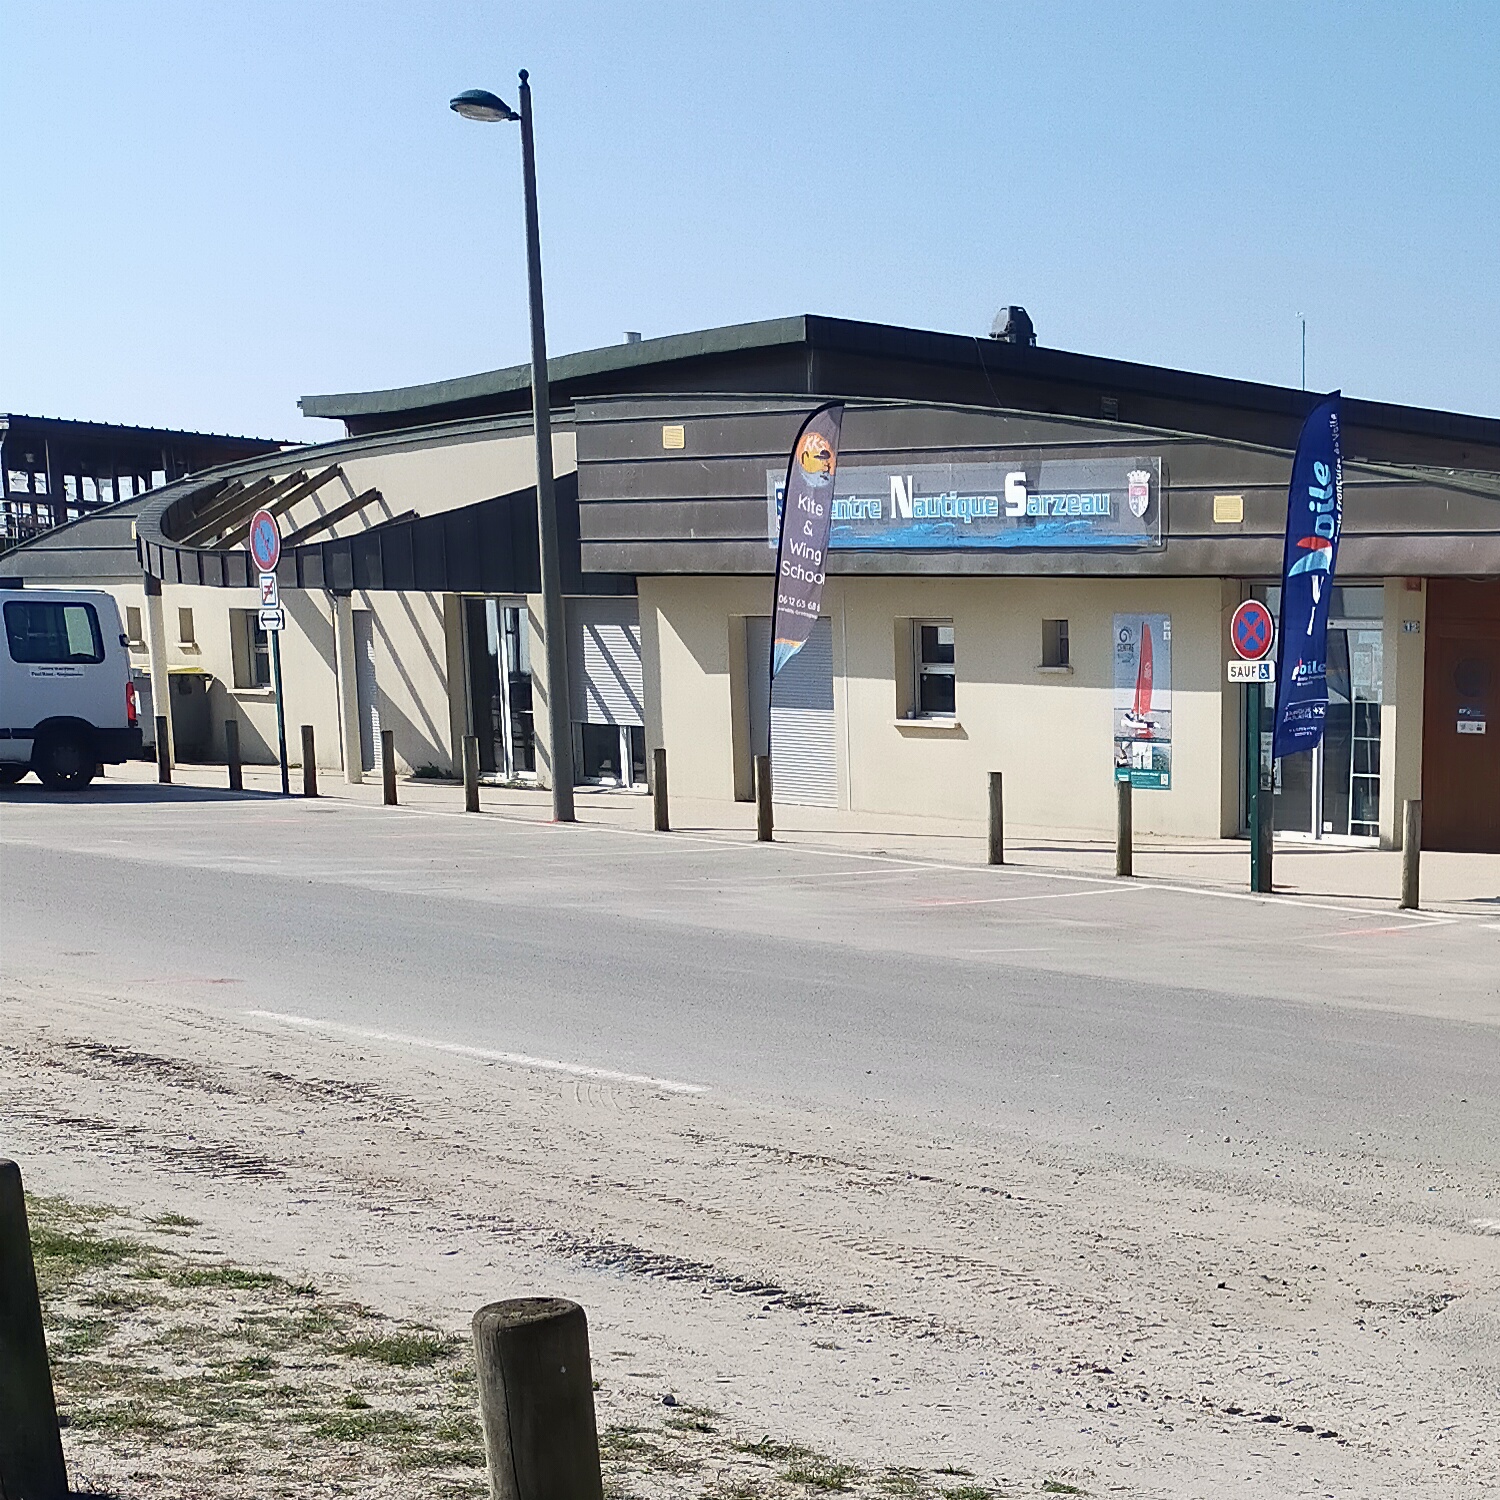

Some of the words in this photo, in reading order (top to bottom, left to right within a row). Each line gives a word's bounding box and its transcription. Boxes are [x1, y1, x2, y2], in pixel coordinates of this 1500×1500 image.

[797, 494, 824, 516] Kite
[890, 475, 999, 523] Nautique
[1004, 472, 1111, 517] Sarzeau
[803, 520, 813, 537] &
[789, 538, 822, 566] Wing
[781, 560, 826, 585] School
[1230, 665, 1257, 678] SAUF
